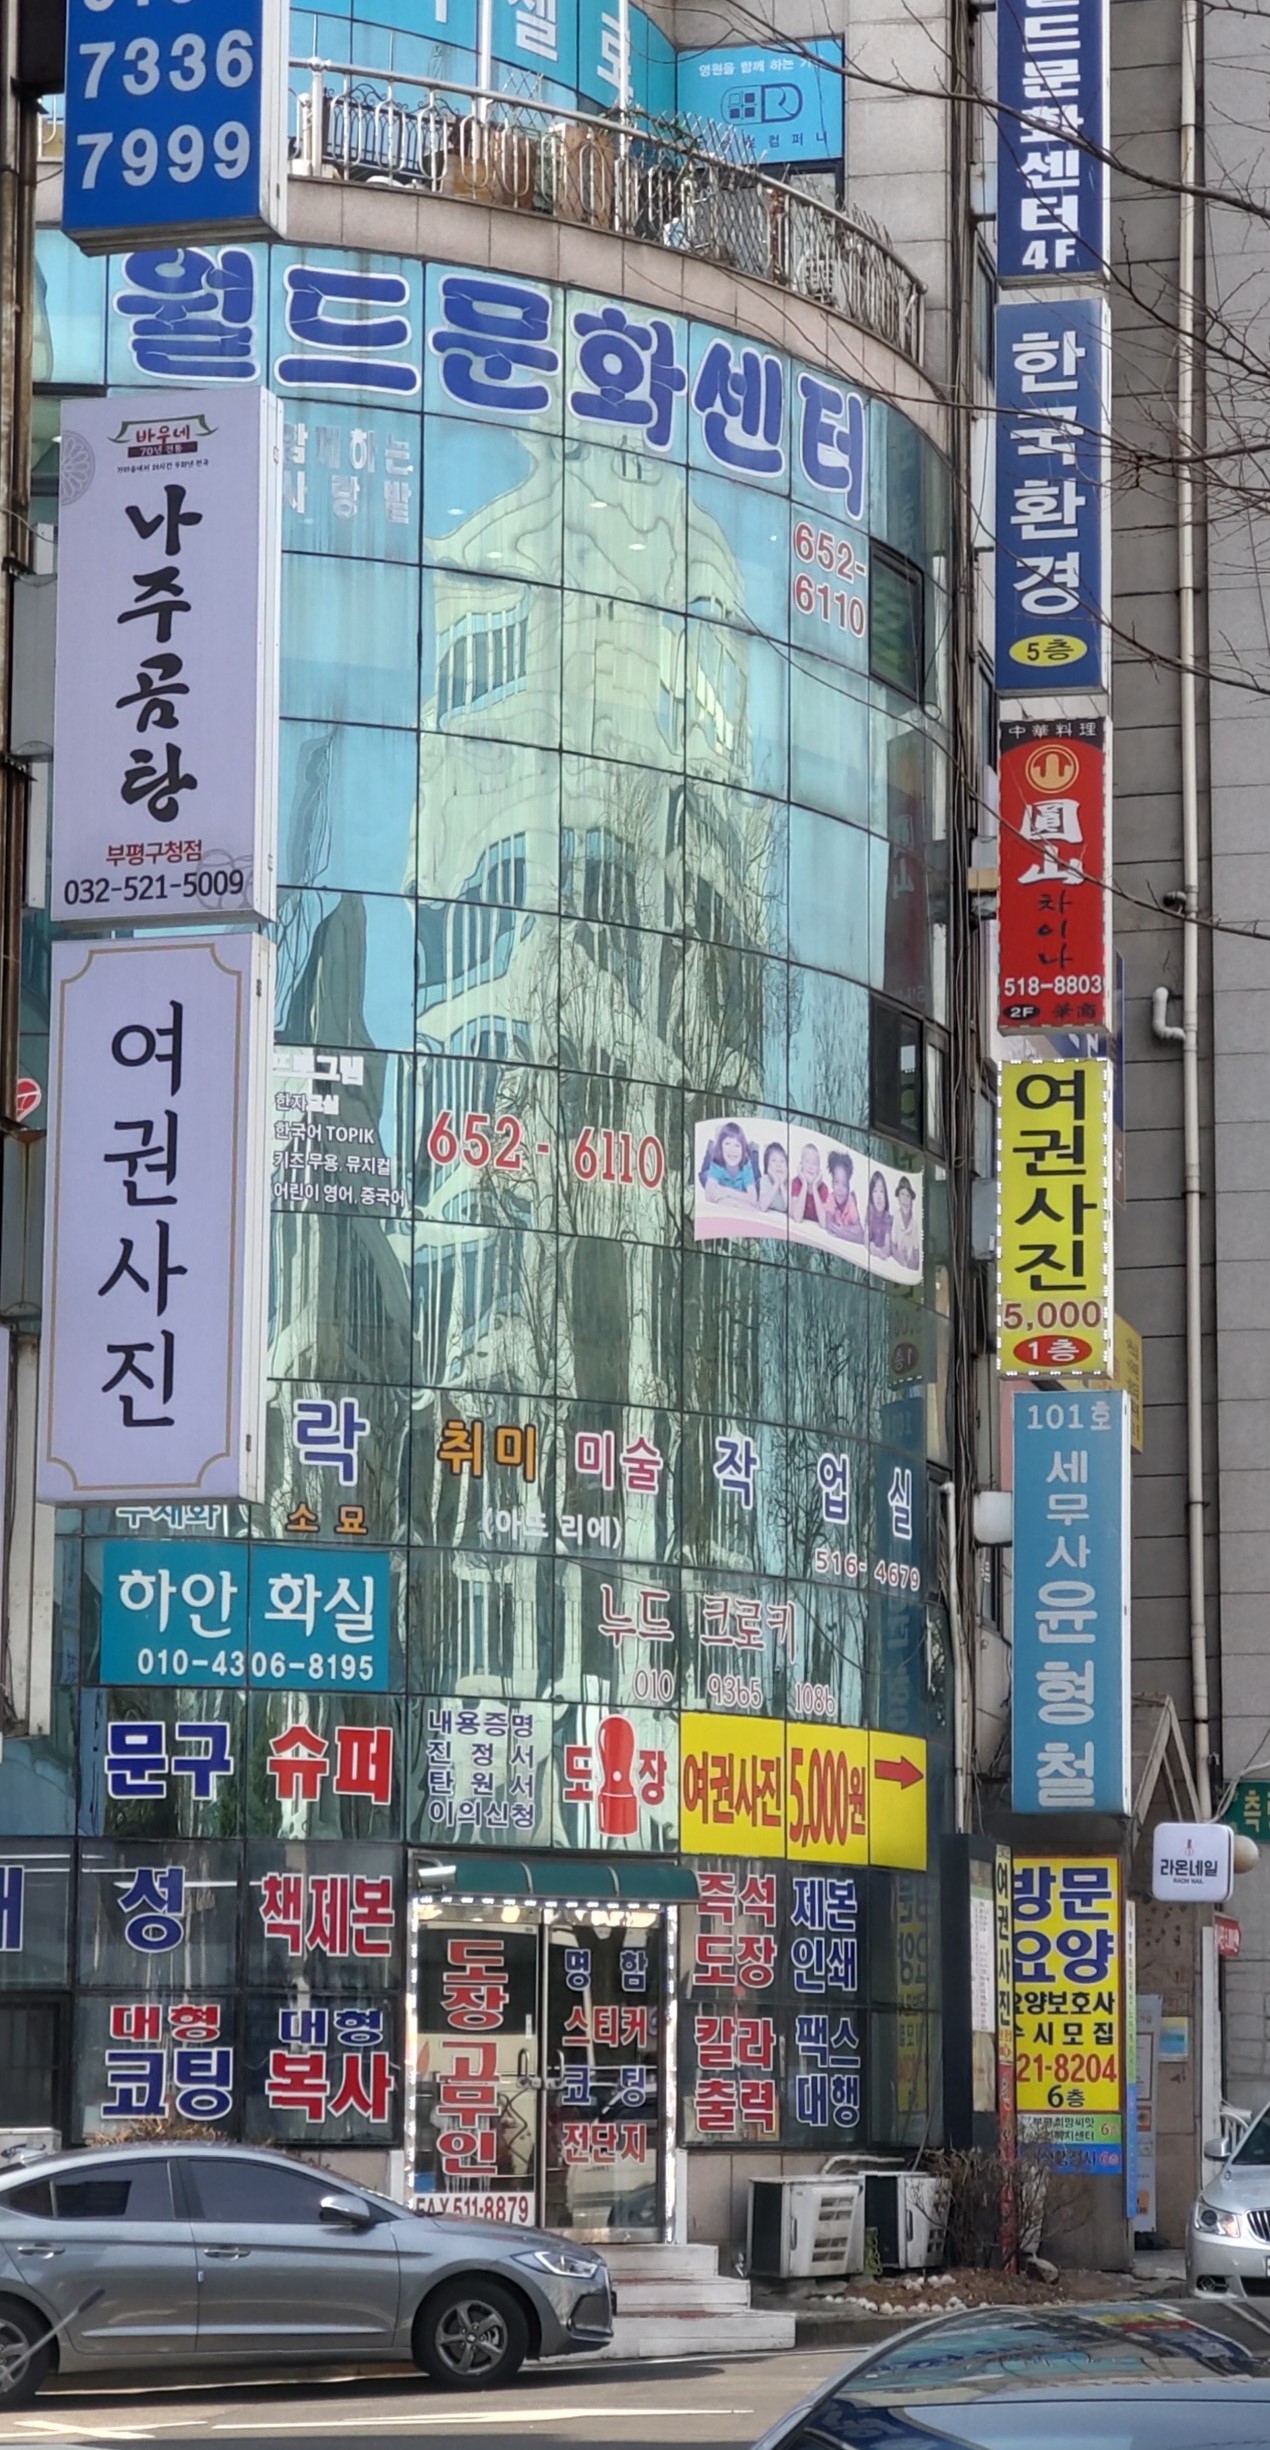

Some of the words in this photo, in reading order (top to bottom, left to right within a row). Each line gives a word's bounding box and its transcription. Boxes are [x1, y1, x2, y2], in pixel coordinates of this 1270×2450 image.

[79, 29, 255, 99] 7336
[699, 62, 735, 77] 영원을
[740, 60, 765, 73] 함께
[769, 59, 795, 71] 하는
[1020, 0, 1083, 232] 드문화센터
[76, 120, 251, 190] 7999
[1022, 237, 1076, 269] 4F
[113, 246, 866, 522] 월드문화센터
[136, 424, 190, 448] 바우네
[1011, 330, 1085, 616] 한국환경
[794, 521, 868, 585] 652-
[794, 572, 866, 640] 6110
[115, 484, 204, 823] 나주곰탕
[1026, 639, 1074, 662] 5층
[1008, 722, 1097, 739] 中華料理
[106, 840, 203, 868] 부평구청점
[63, 869, 245, 906] 032-521-5009
[1036, 889, 1073, 971] 차이나
[1003, 975, 1102, 997] 518-8803
[1010, 1006, 1035, 1018] 2F
[274, 1120, 322, 1142] 한국어
[326, 1125, 374, 1144] TOPIK
[273, 1151, 305, 1170] 키즈
[346, 1155, 391, 1176] 뮤지컬
[1012, 1069, 1098, 1292] 여권사진
[96, 999, 189, 1429] 여권사진
[274, 1182, 319, 1202] 어린이
[360, 1186, 405, 1207] 중국어
[1002, 1300, 1102, 1331] 5,000
[1028, 1337, 1080, 1363] 1층
[1027, 1402, 1112, 1430] 101호
[294, 1398, 370, 1486] 락
[437, 1420, 537, 1483] 취미
[575, 1431, 664, 1495] 미술
[287, 1502, 369, 1535] 소묘
[1045, 1450, 1091, 1570] 세무사
[118, 1569, 239, 1638] 하안
[264, 1573, 375, 1643] 화실
[598, 1584, 674, 1648] 누드
[699, 1594, 796, 1664] 크로키
[137, 1647, 374, 1681] 010-4306-8195
[633, 1669, 673, 1703] 010
[1034, 1580, 1098, 1809] 윤형철
[427, 1710, 534, 1738] 내용증명
[104, 1721, 234, 1800] 문구
[266, 1724, 393, 1806] 슈퍼
[426, 1741, 535, 1769] 진정서
[427, 1770, 535, 1799] 탄원서
[683, 1750, 782, 1828] 여권사진
[788, 1747, 867, 1849] 5,000원
[429, 1801, 535, 1829] 이의신청
[1160, 1859, 1217, 1877] 라온네일
[259, 1871, 395, 1957] 책제본
[695, 1872, 777, 1928] 즉석
[791, 1877, 858, 1932] 제본
[1014, 1865, 1112, 1921] 방문
[692, 1933, 778, 1989] 도장
[791, 1937, 858, 1993] 인쇄
[996, 1862, 1011, 2026] 여권사진
[1014, 1928, 1114, 1984] 요양
[440, 1939, 509, 2031] 도장
[563, 1949, 648, 1992] 명함
[110, 2004, 220, 2042] 대형
[278, 2008, 384, 2046] 대형
[562, 2006, 648, 2047] 스티커
[693, 2015, 776, 2071] 칼라
[795, 2014, 861, 2069] 팩스
[100, 2047, 234, 2121] 코팅
[264, 2051, 395, 2124] 복사
[436, 2040, 502, 2177] 고무인
[561, 2064, 647, 2107] 코팅
[694, 2078, 776, 2134] 출력
[795, 2074, 861, 2128] 대행
[1047, 2084, 1085, 2108] 6층
[562, 2123, 647, 2165] 전단지
